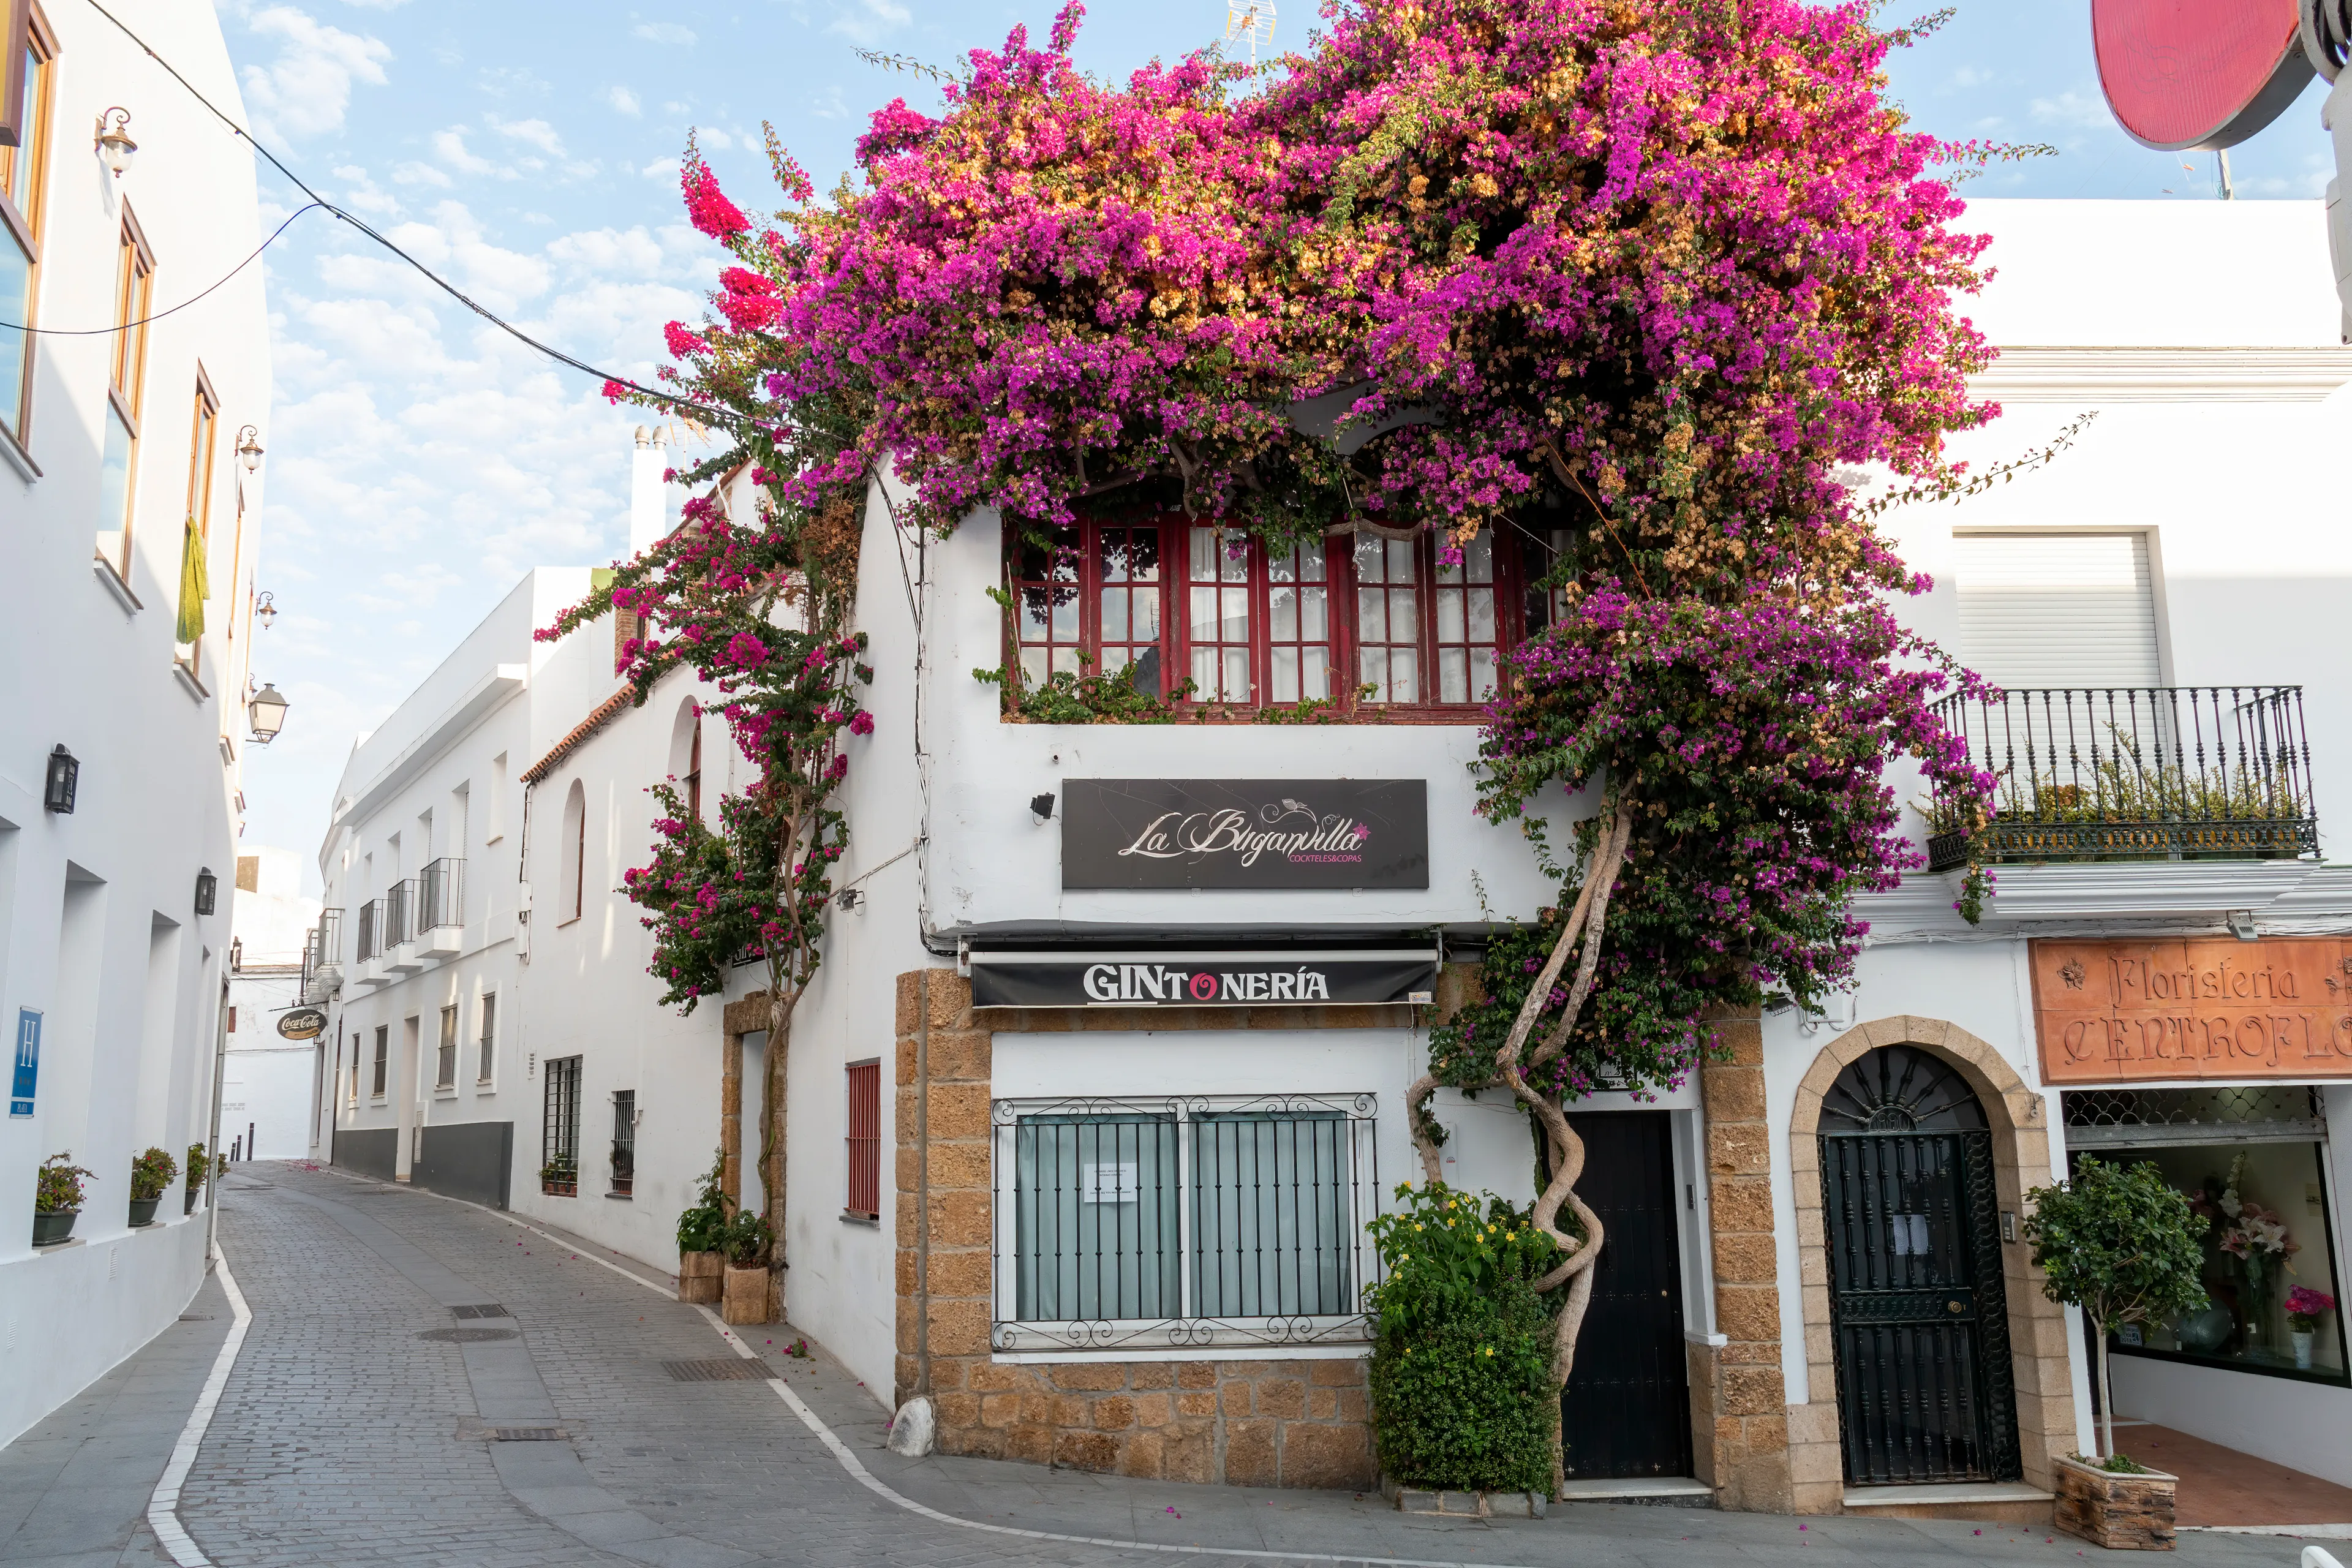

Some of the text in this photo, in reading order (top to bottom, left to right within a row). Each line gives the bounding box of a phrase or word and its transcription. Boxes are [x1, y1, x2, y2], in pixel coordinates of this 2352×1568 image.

[1118, 809, 1363, 867] La Buganvilla
[20, 1019, 36, 1067] H
[281, 1014, 321, 1030] Coca-Cola
